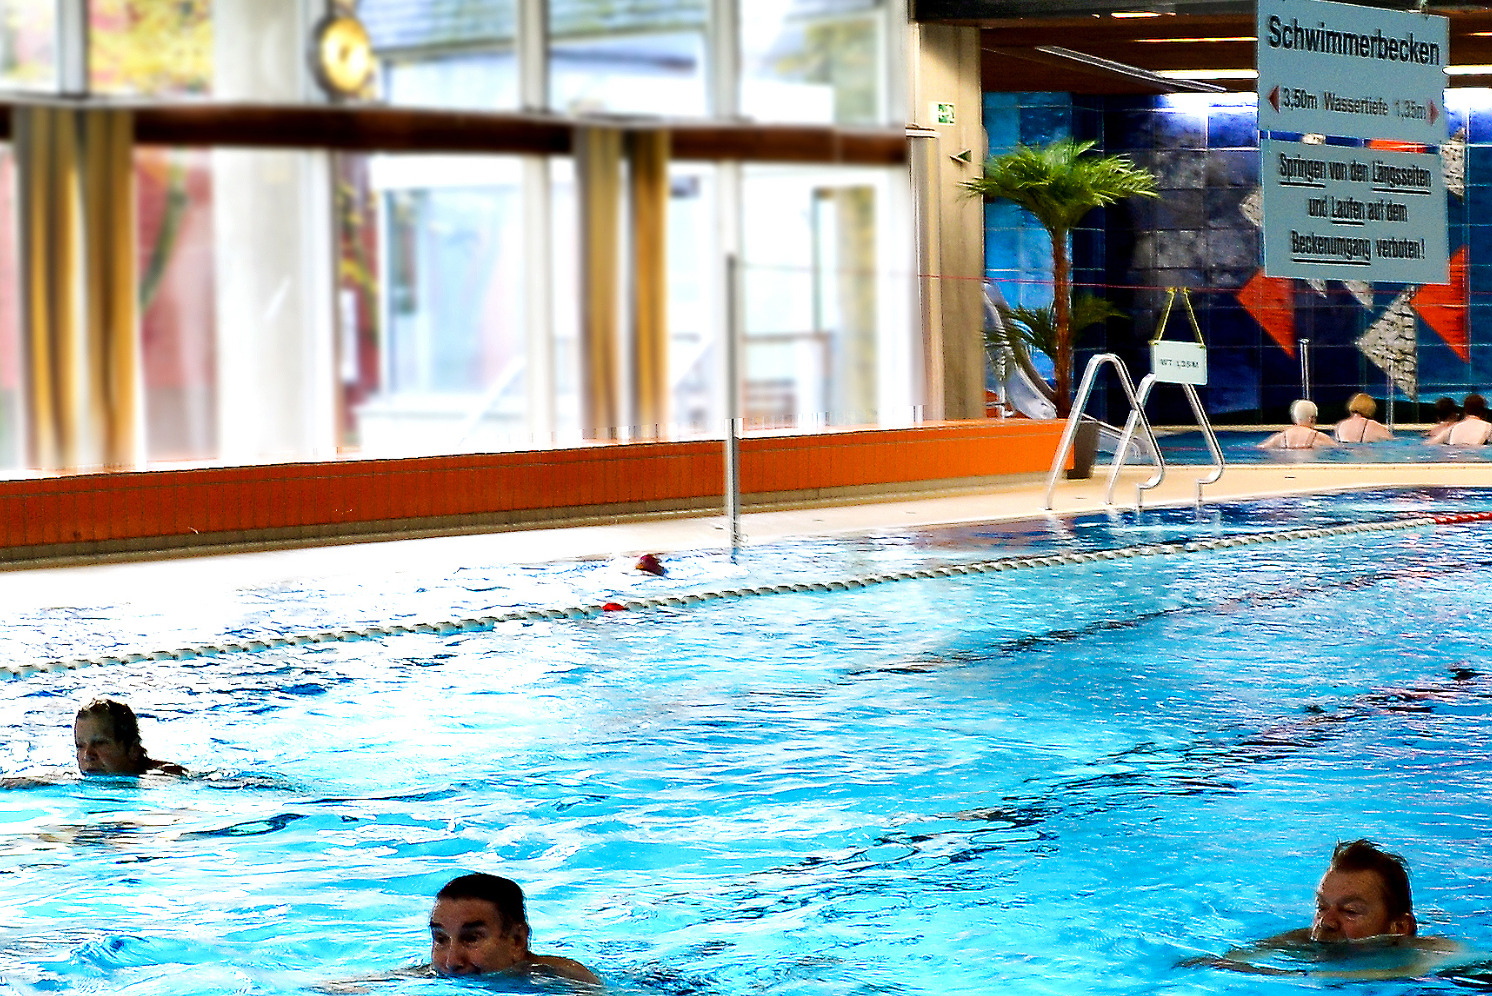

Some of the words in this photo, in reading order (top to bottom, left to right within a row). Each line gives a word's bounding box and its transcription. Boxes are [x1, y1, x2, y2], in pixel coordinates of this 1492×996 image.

[1268, 15, 1440, 65] Schwimmerbecken
[1283, 87, 1318, 110] 3,50m
[1324, 91, 1389, 116] Wassertiefe
[1394, 99, 1427, 121] 1,35m
[1279, 152, 1326, 181] Springen
[1329, 161, 1347, 181] von
[1350, 160, 1368, 182] den
[1372, 161, 1432, 188] Längsseiten
[1308, 195, 1327, 217] und
[1331, 196, 1365, 220] Laufen
[1368, 199, 1384, 221] auf
[1386, 199, 1408, 222] dem
[1291, 230, 1371, 261] Beckenumgang
